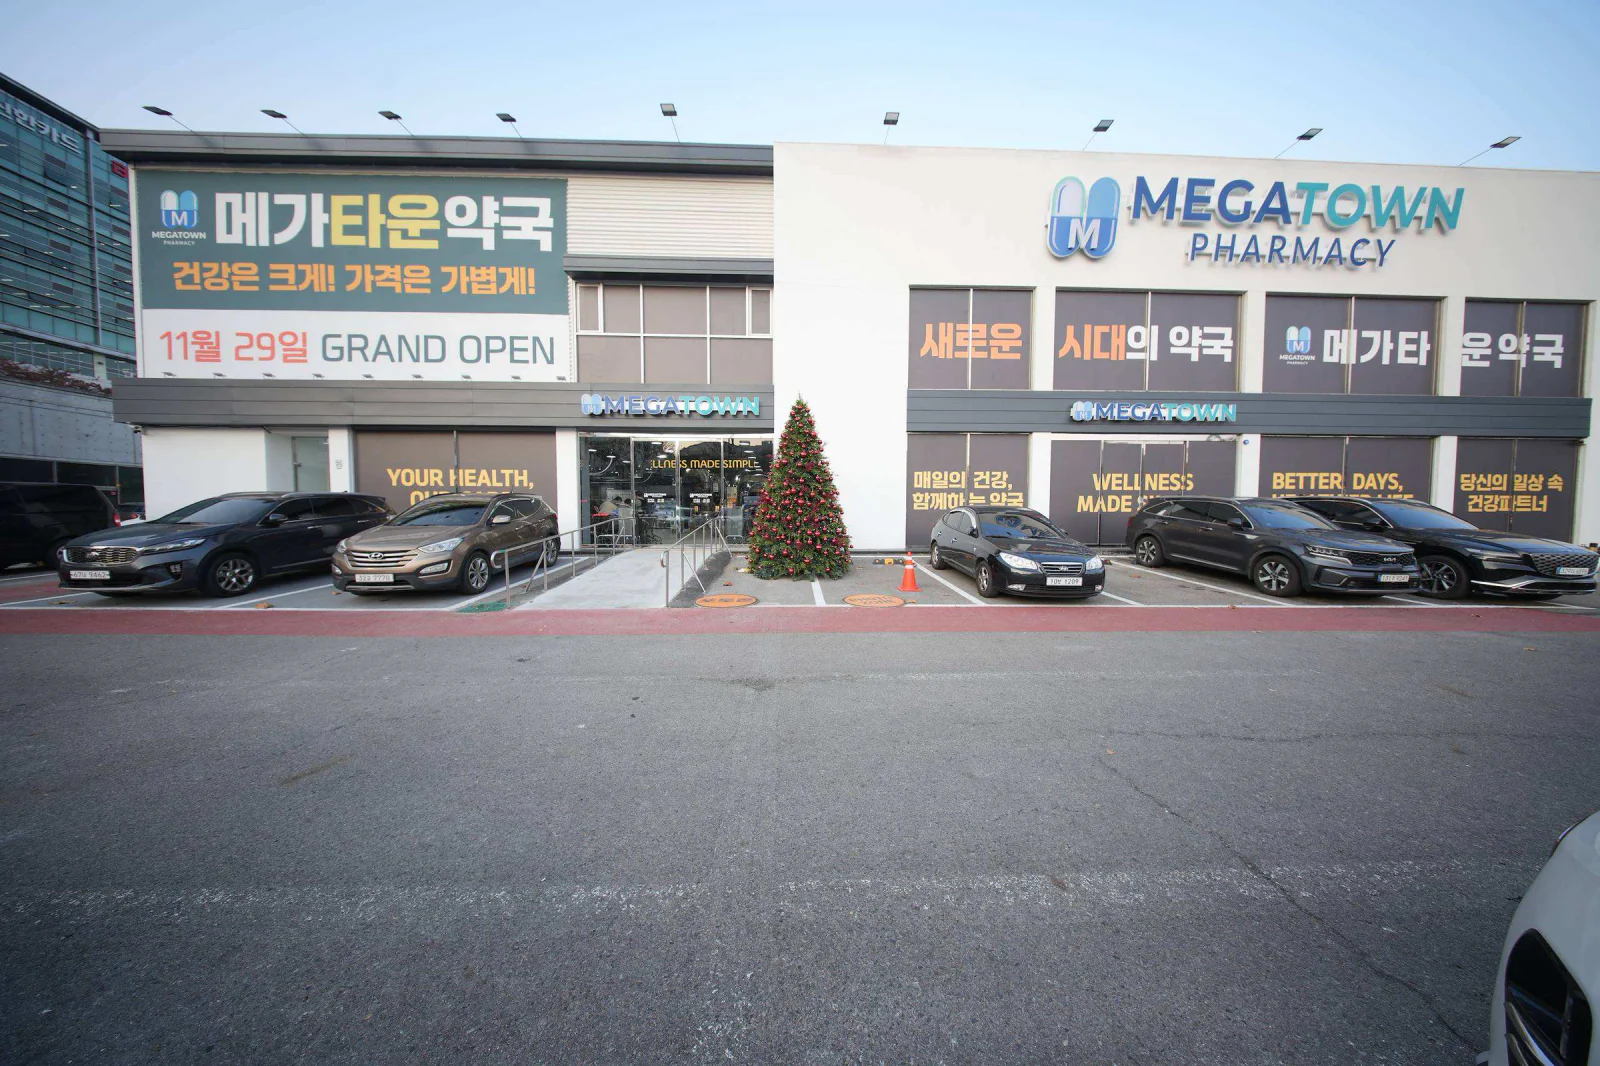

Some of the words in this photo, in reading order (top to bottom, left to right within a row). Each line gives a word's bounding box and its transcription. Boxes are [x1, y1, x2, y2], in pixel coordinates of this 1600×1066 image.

[1131, 175, 1465, 230] MEGATOWN
[215, 191, 554, 252] 메가타운약국
[151, 231, 207, 239] MEGATOWN
[1190, 233, 1396, 268] PHARMACY
[172, 261, 259, 292] 건강은
[269, 262, 335, 292] 크게!
[345, 264, 431, 294] 가격은
[440, 265, 536, 295] 가볍게!
[159, 330, 221, 363] 11월
[234, 331, 308, 364] 29일
[321, 333, 447, 364] GRAND
[459, 334, 555, 365] OPEN
[919, 323, 1023, 359] 새로운
[1058, 323, 1158, 361] 시대의
[1169, 325, 1234, 362] 약국
[603, 395, 760, 416] MEGATOWN
[1094, 402, 1237, 422] MEGATOWN
[690, 459, 720, 469] MADE
[386, 468, 444, 487] YOUR
[449, 468, 534, 490] HEALTH,
[913, 471, 966, 489] 매일의
[973, 471, 1013, 491] 건강,
[1092, 473, 1194, 491] WELLNESS
[1272, 472, 1344, 490] BETTER
[1352, 473, 1403, 492] DAYS,
[1460, 474, 1508, 492] 당신의
[1513, 474, 1543, 492] 일상
[1547, 474, 1564, 492] 속
[1076, 495, 1132, 513] MADE
[1467, 495, 1548, 513] 건강파트너
